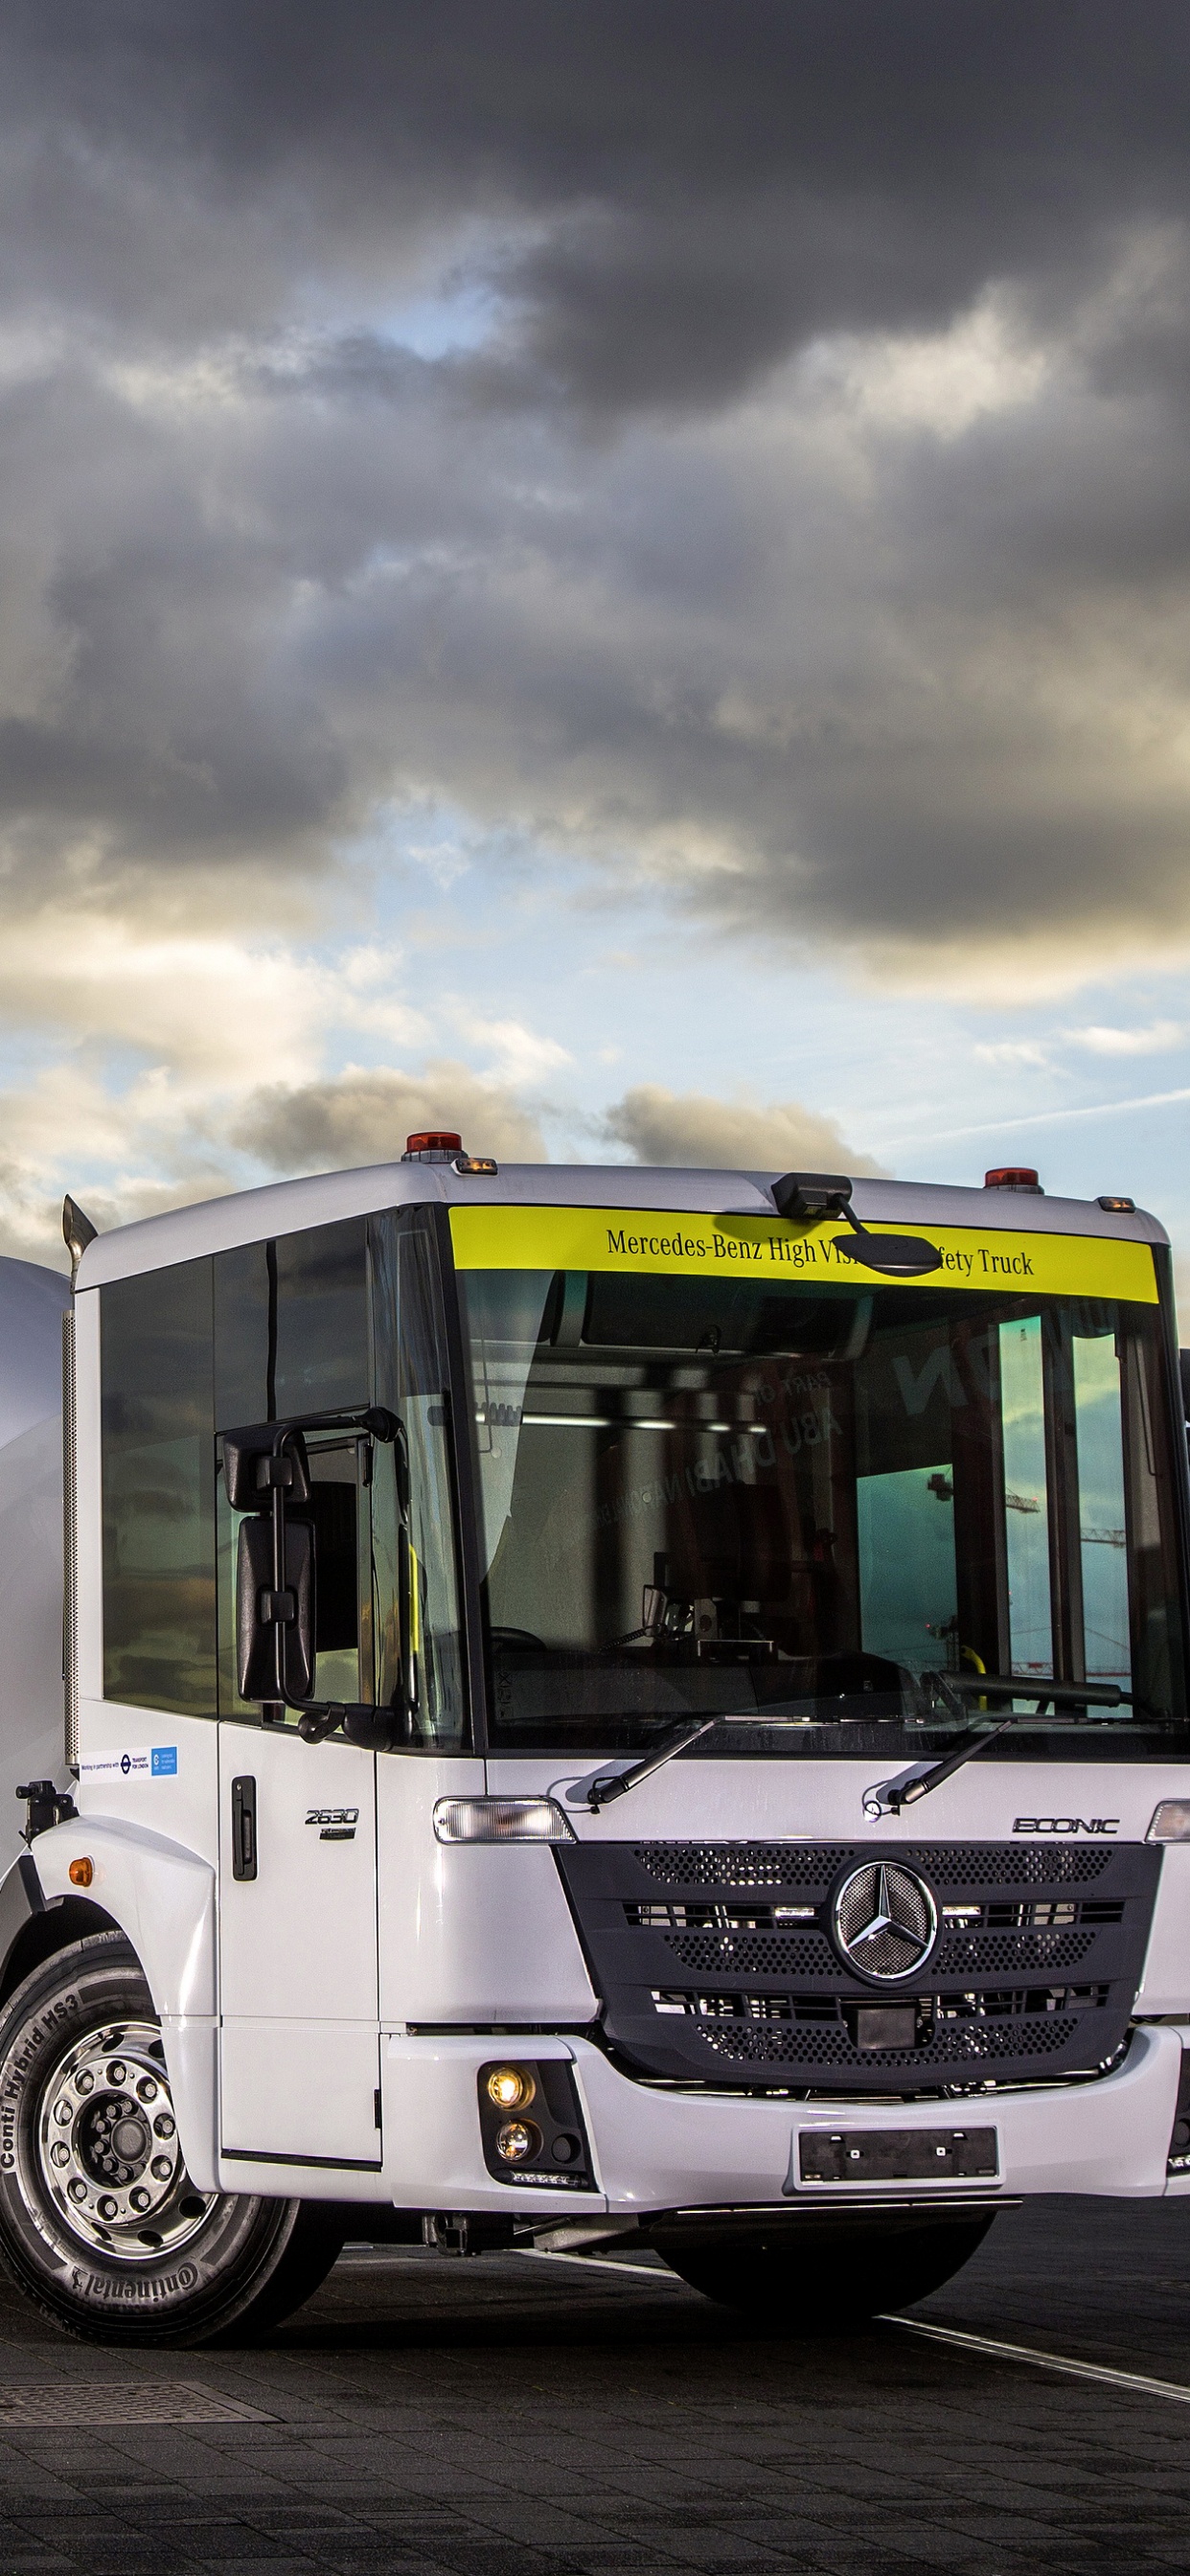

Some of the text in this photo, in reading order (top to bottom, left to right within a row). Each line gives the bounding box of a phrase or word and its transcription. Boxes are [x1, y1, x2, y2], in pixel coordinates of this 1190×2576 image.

[606, 1230, 764, 1260] Mercedes-Benz
[767, 1237, 817, 1268] High
[939, 1247, 973, 1277] fety
[978, 1249, 1035, 1276] Truck
[305, 1808, 359, 1825] 2630
[1012, 1818, 1120, 1833] ECONIC
[1, 1993, 79, 2169] Conti Hybrid HS3
[84, 2262, 198, 2303] Continental
